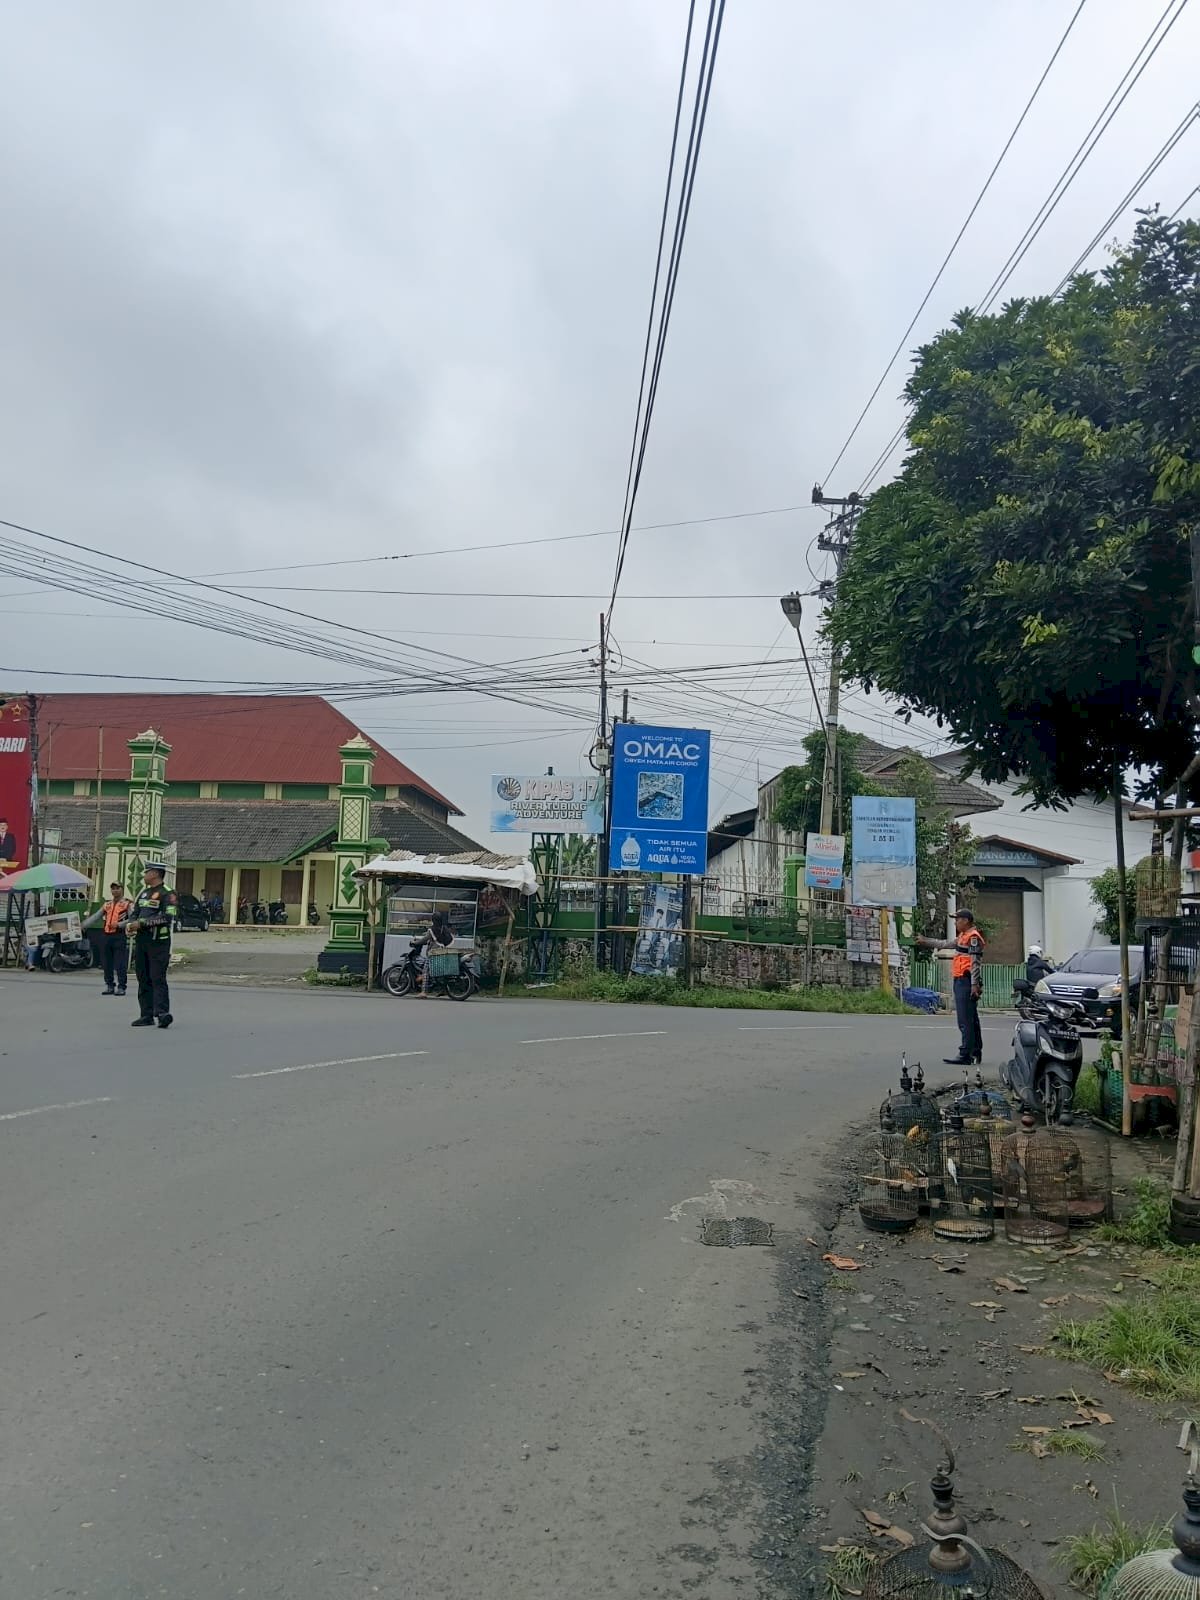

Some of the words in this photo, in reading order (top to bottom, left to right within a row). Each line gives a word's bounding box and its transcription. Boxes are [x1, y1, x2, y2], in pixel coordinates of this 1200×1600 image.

[623, 740, 701, 760] OMAC
[525, 779, 574, 801] KIPAS
[580, 779, 600, 801] 17
[511, 802, 544, 811] RIVER
[545, 802, 587, 811] TUBING
[515, 811, 583, 820] ADVENTURE
[647, 853, 670, 864] AQUA
